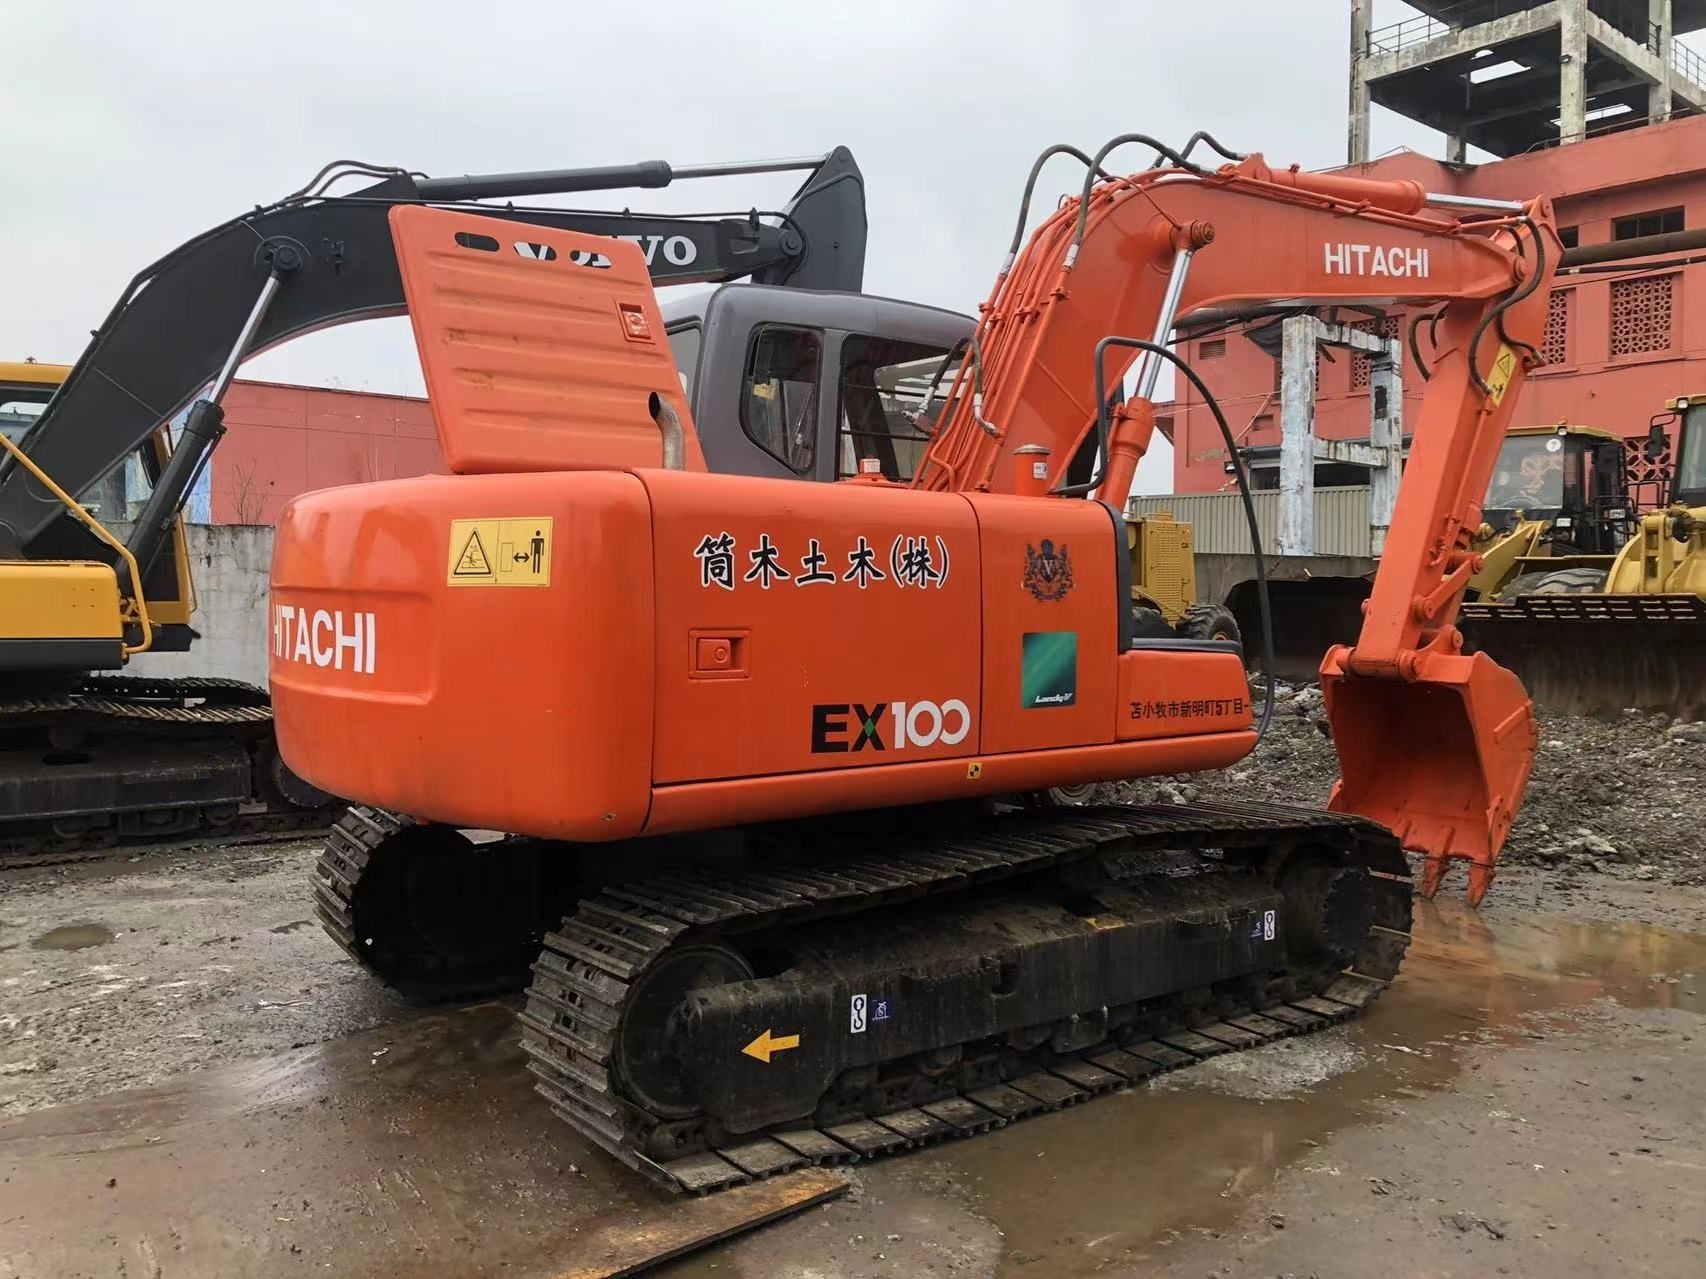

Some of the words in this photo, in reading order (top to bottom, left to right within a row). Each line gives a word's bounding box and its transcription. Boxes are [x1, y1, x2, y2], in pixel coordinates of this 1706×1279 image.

[1324, 242, 1429, 278] HITACHI
[272, 604, 376, 674] HITACHI
[811, 699, 971, 753] EX100
